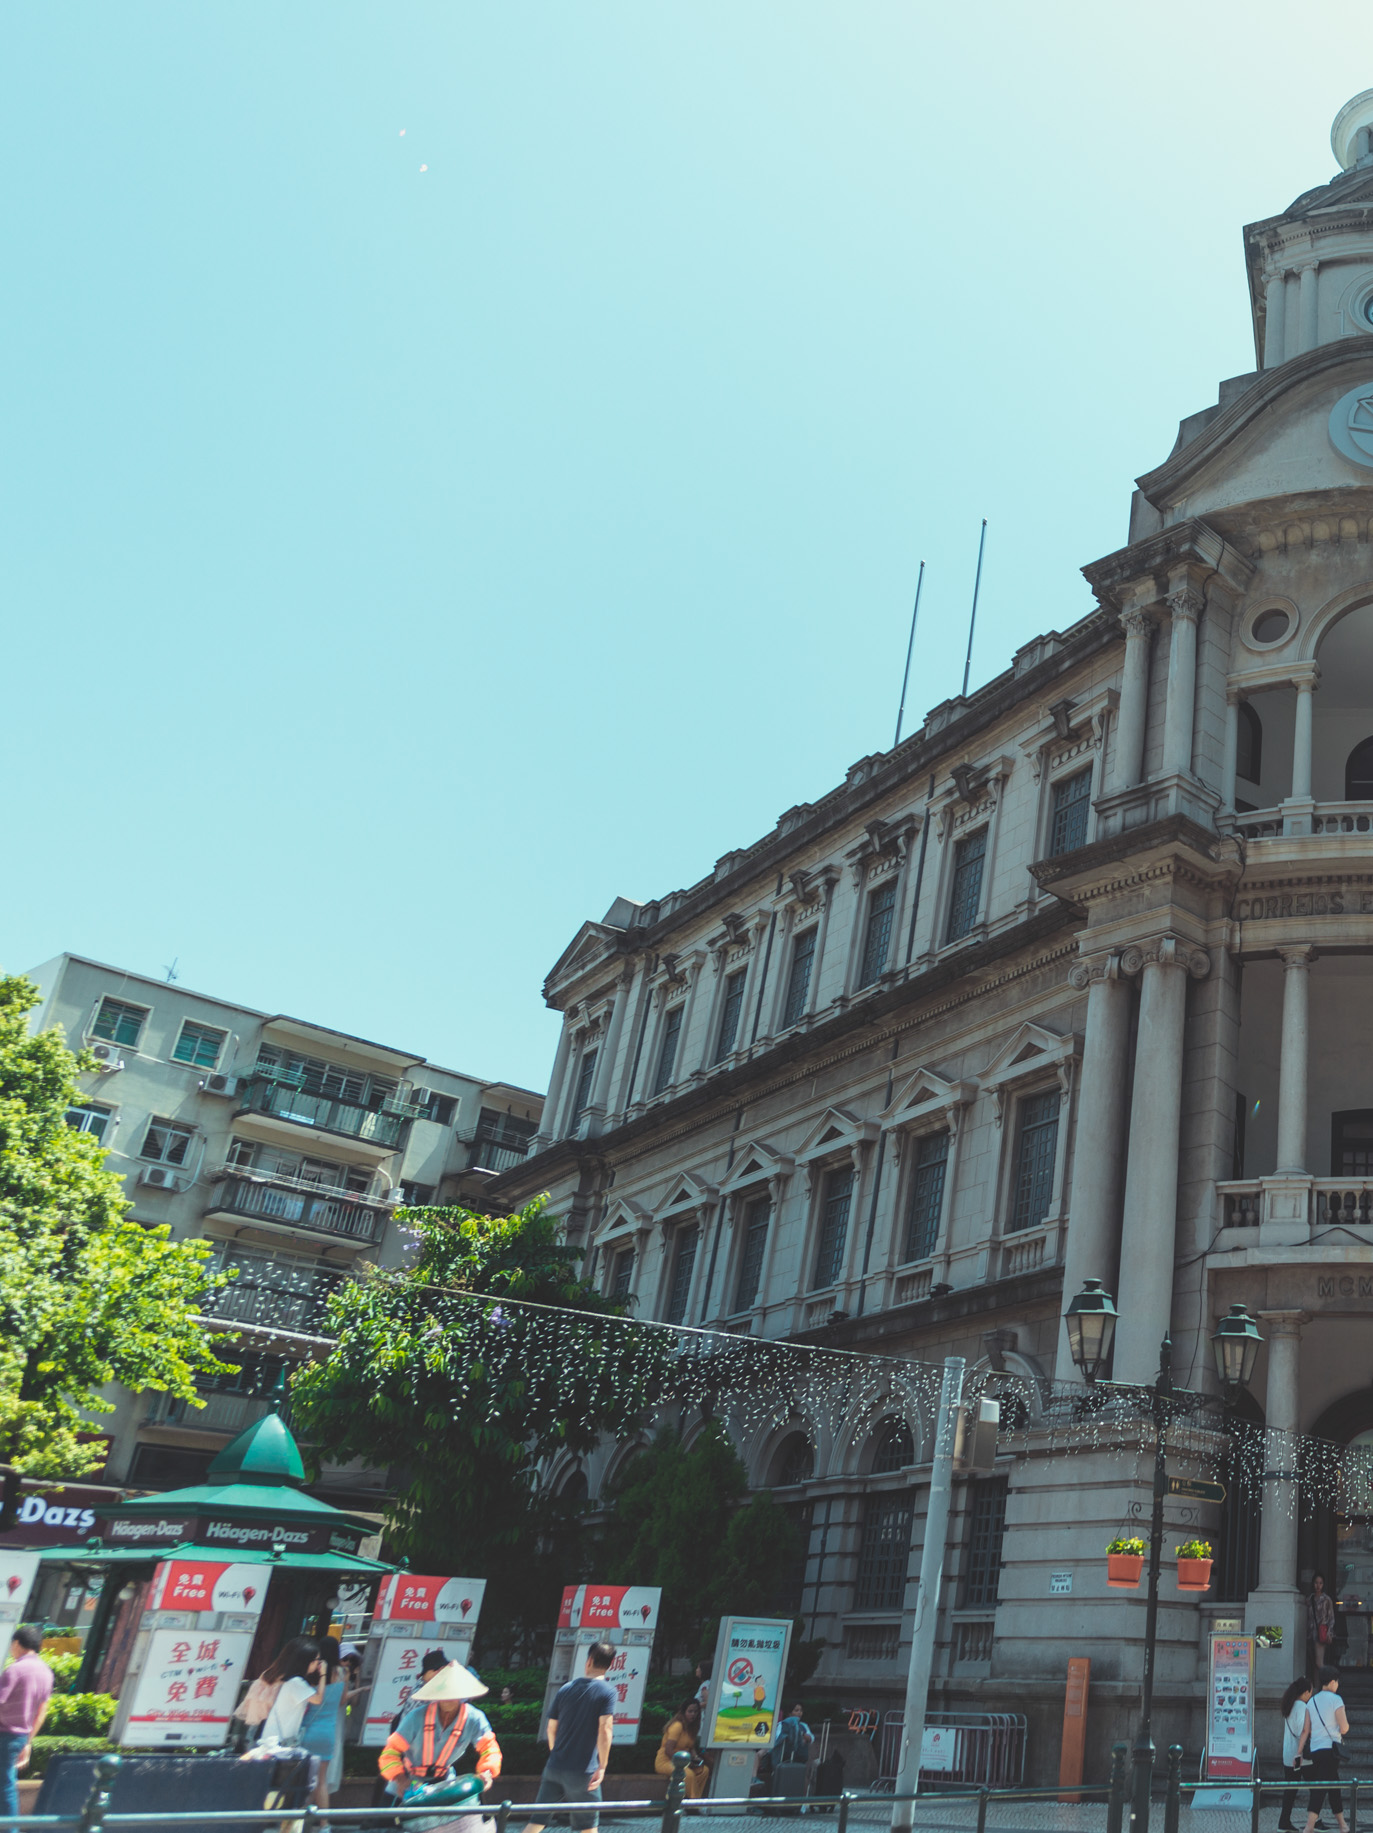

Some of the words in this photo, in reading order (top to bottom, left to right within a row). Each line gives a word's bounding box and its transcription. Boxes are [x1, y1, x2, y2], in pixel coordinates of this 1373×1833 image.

[1236, 890, 1344, 921] CORREIOS
[1359, 891, 1373, 914] E
[111, 1520, 184, 1540] Häagen-Dazs
[206, 1522, 309, 1544] Häagen-Dazs
[172, 1586, 207, 1598] Free
[400, 1598, 429, 1610] Free
[589, 1606, 614, 1617] Free
[168, 1639, 221, 1664] 全城
[165, 1675, 219, 1704] 免費
